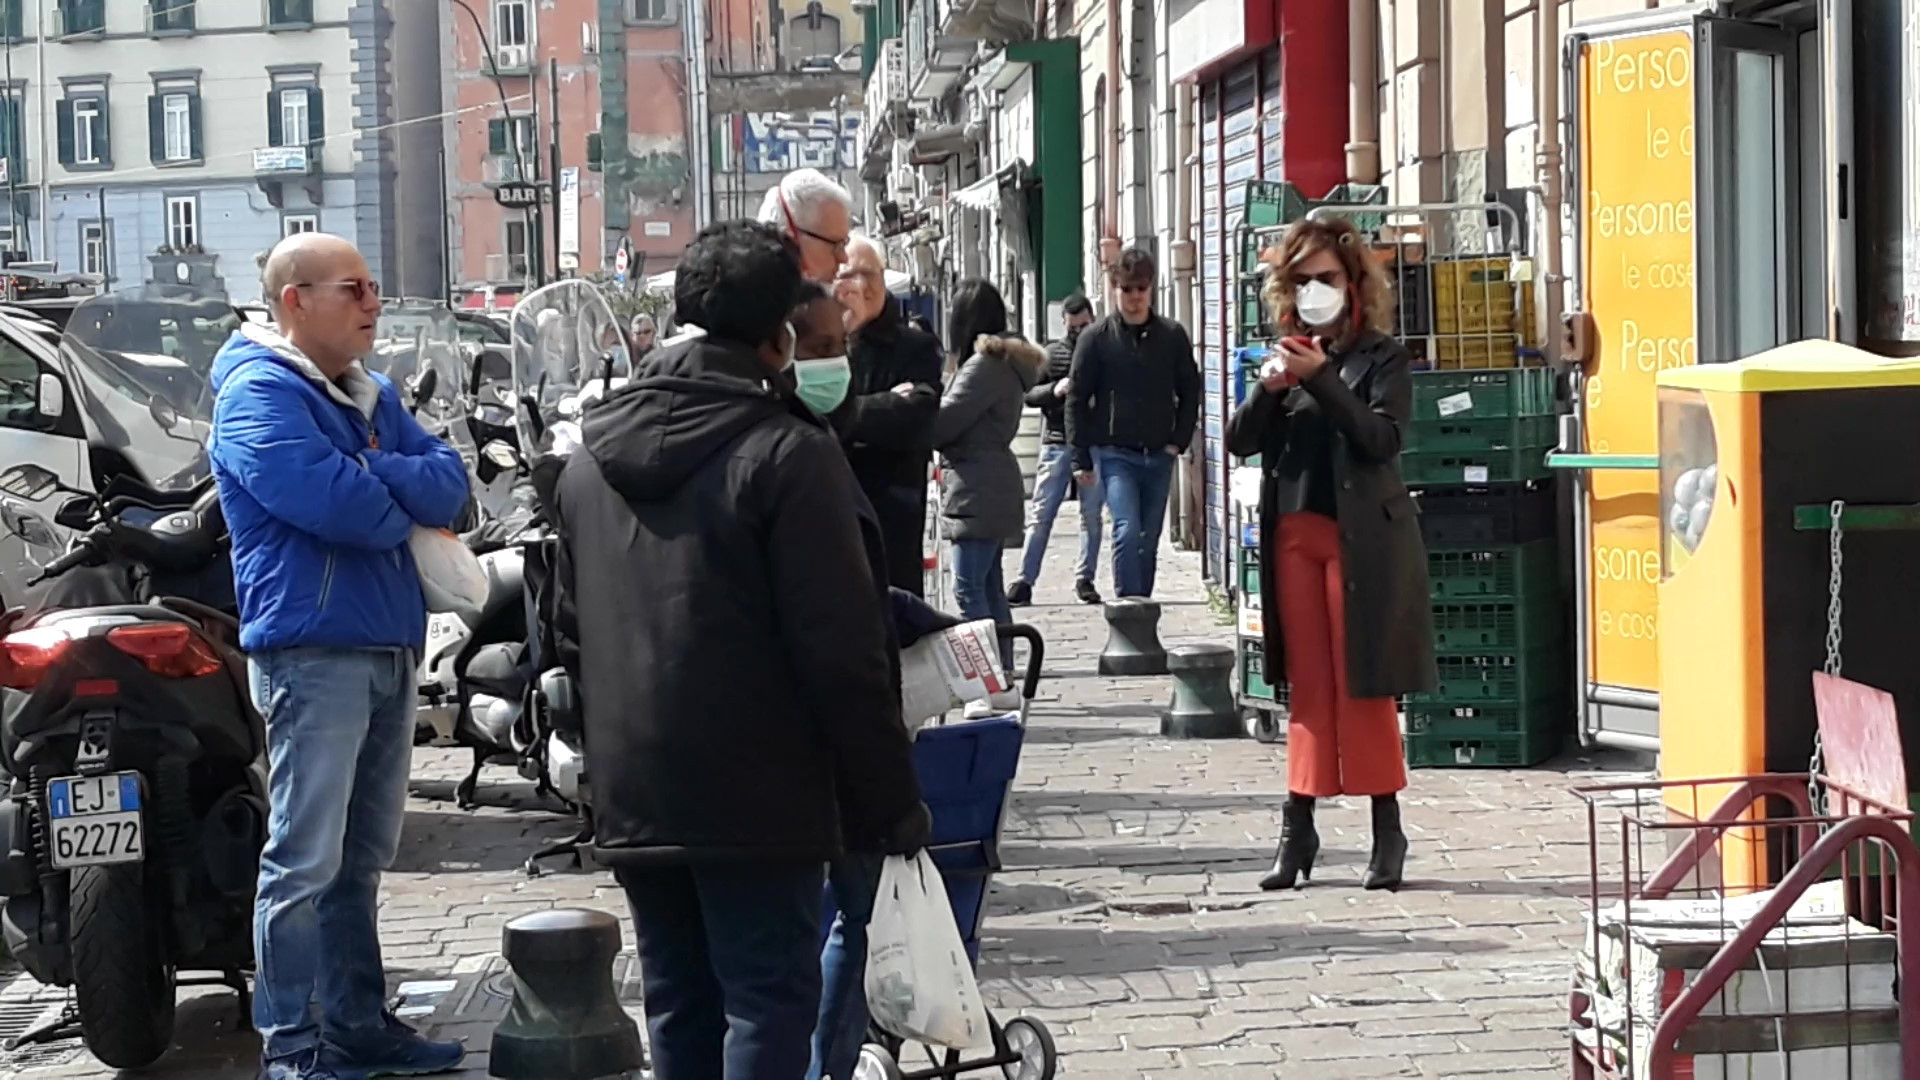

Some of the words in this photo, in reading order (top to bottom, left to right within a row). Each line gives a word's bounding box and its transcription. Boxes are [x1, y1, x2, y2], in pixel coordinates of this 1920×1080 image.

[1646, 107, 1670, 158] le
[500, 188, 536, 202] BAR
[1621, 250, 1640, 290] le
[71, 778, 105, 813] EJ
[56, 821, 140, 859] 62272
